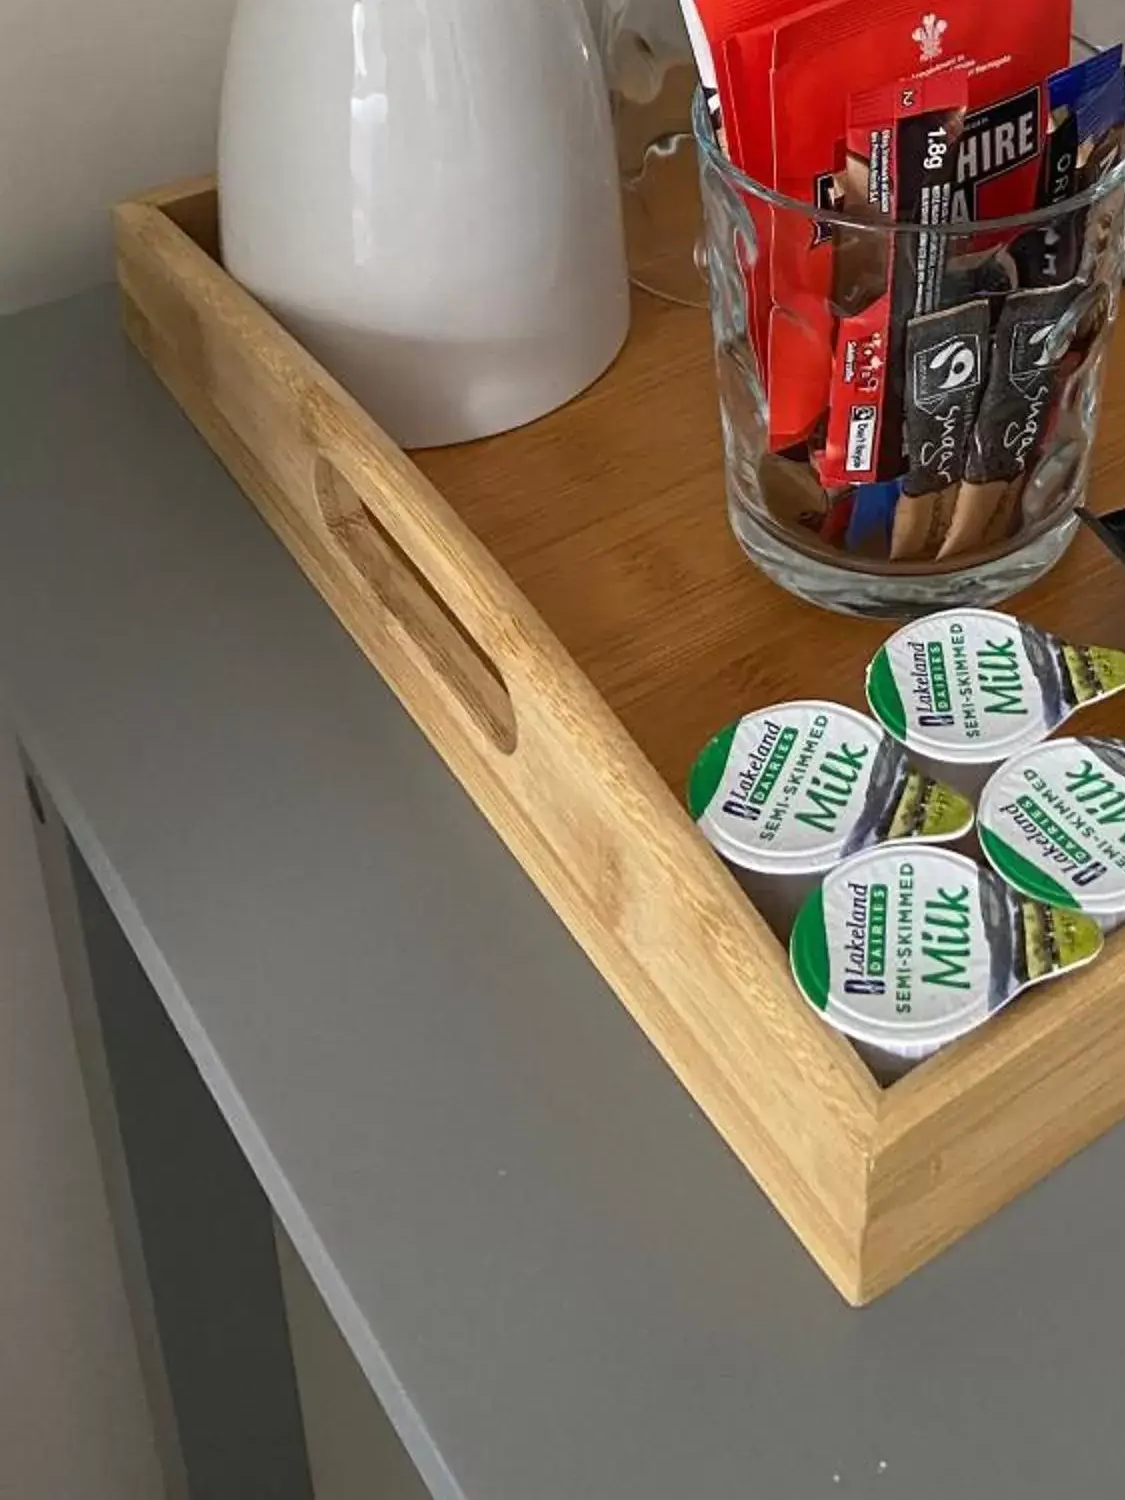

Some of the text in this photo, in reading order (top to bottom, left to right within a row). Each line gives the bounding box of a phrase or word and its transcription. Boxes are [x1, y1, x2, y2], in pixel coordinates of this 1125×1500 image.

[923, 126, 948, 170] 1.8g
[920, 404, 961, 483] sugar
[907, 641, 933, 713] Lakeland
[930, 645, 949, 710] DAIRIES
[950, 623, 980, 738] SEMI-SKIMMED
[976, 637, 1028, 714] Milk
[730, 720, 781, 801] Lakeland
[753, 732, 795, 799] DAIRIES
[759, 715, 828, 841] SEMI-SKIMMED
[794, 742, 869, 833] Milk
[999, 803, 1079, 875] Lakeland
[1022, 800, 1089, 861] DAIRIES
[844, 882, 868, 977] Lakeland
[869, 889, 886, 972] DAIRIES
[896, 862, 914, 1013] SEMI-SKIMMED
[921, 885, 971, 989] Milk
